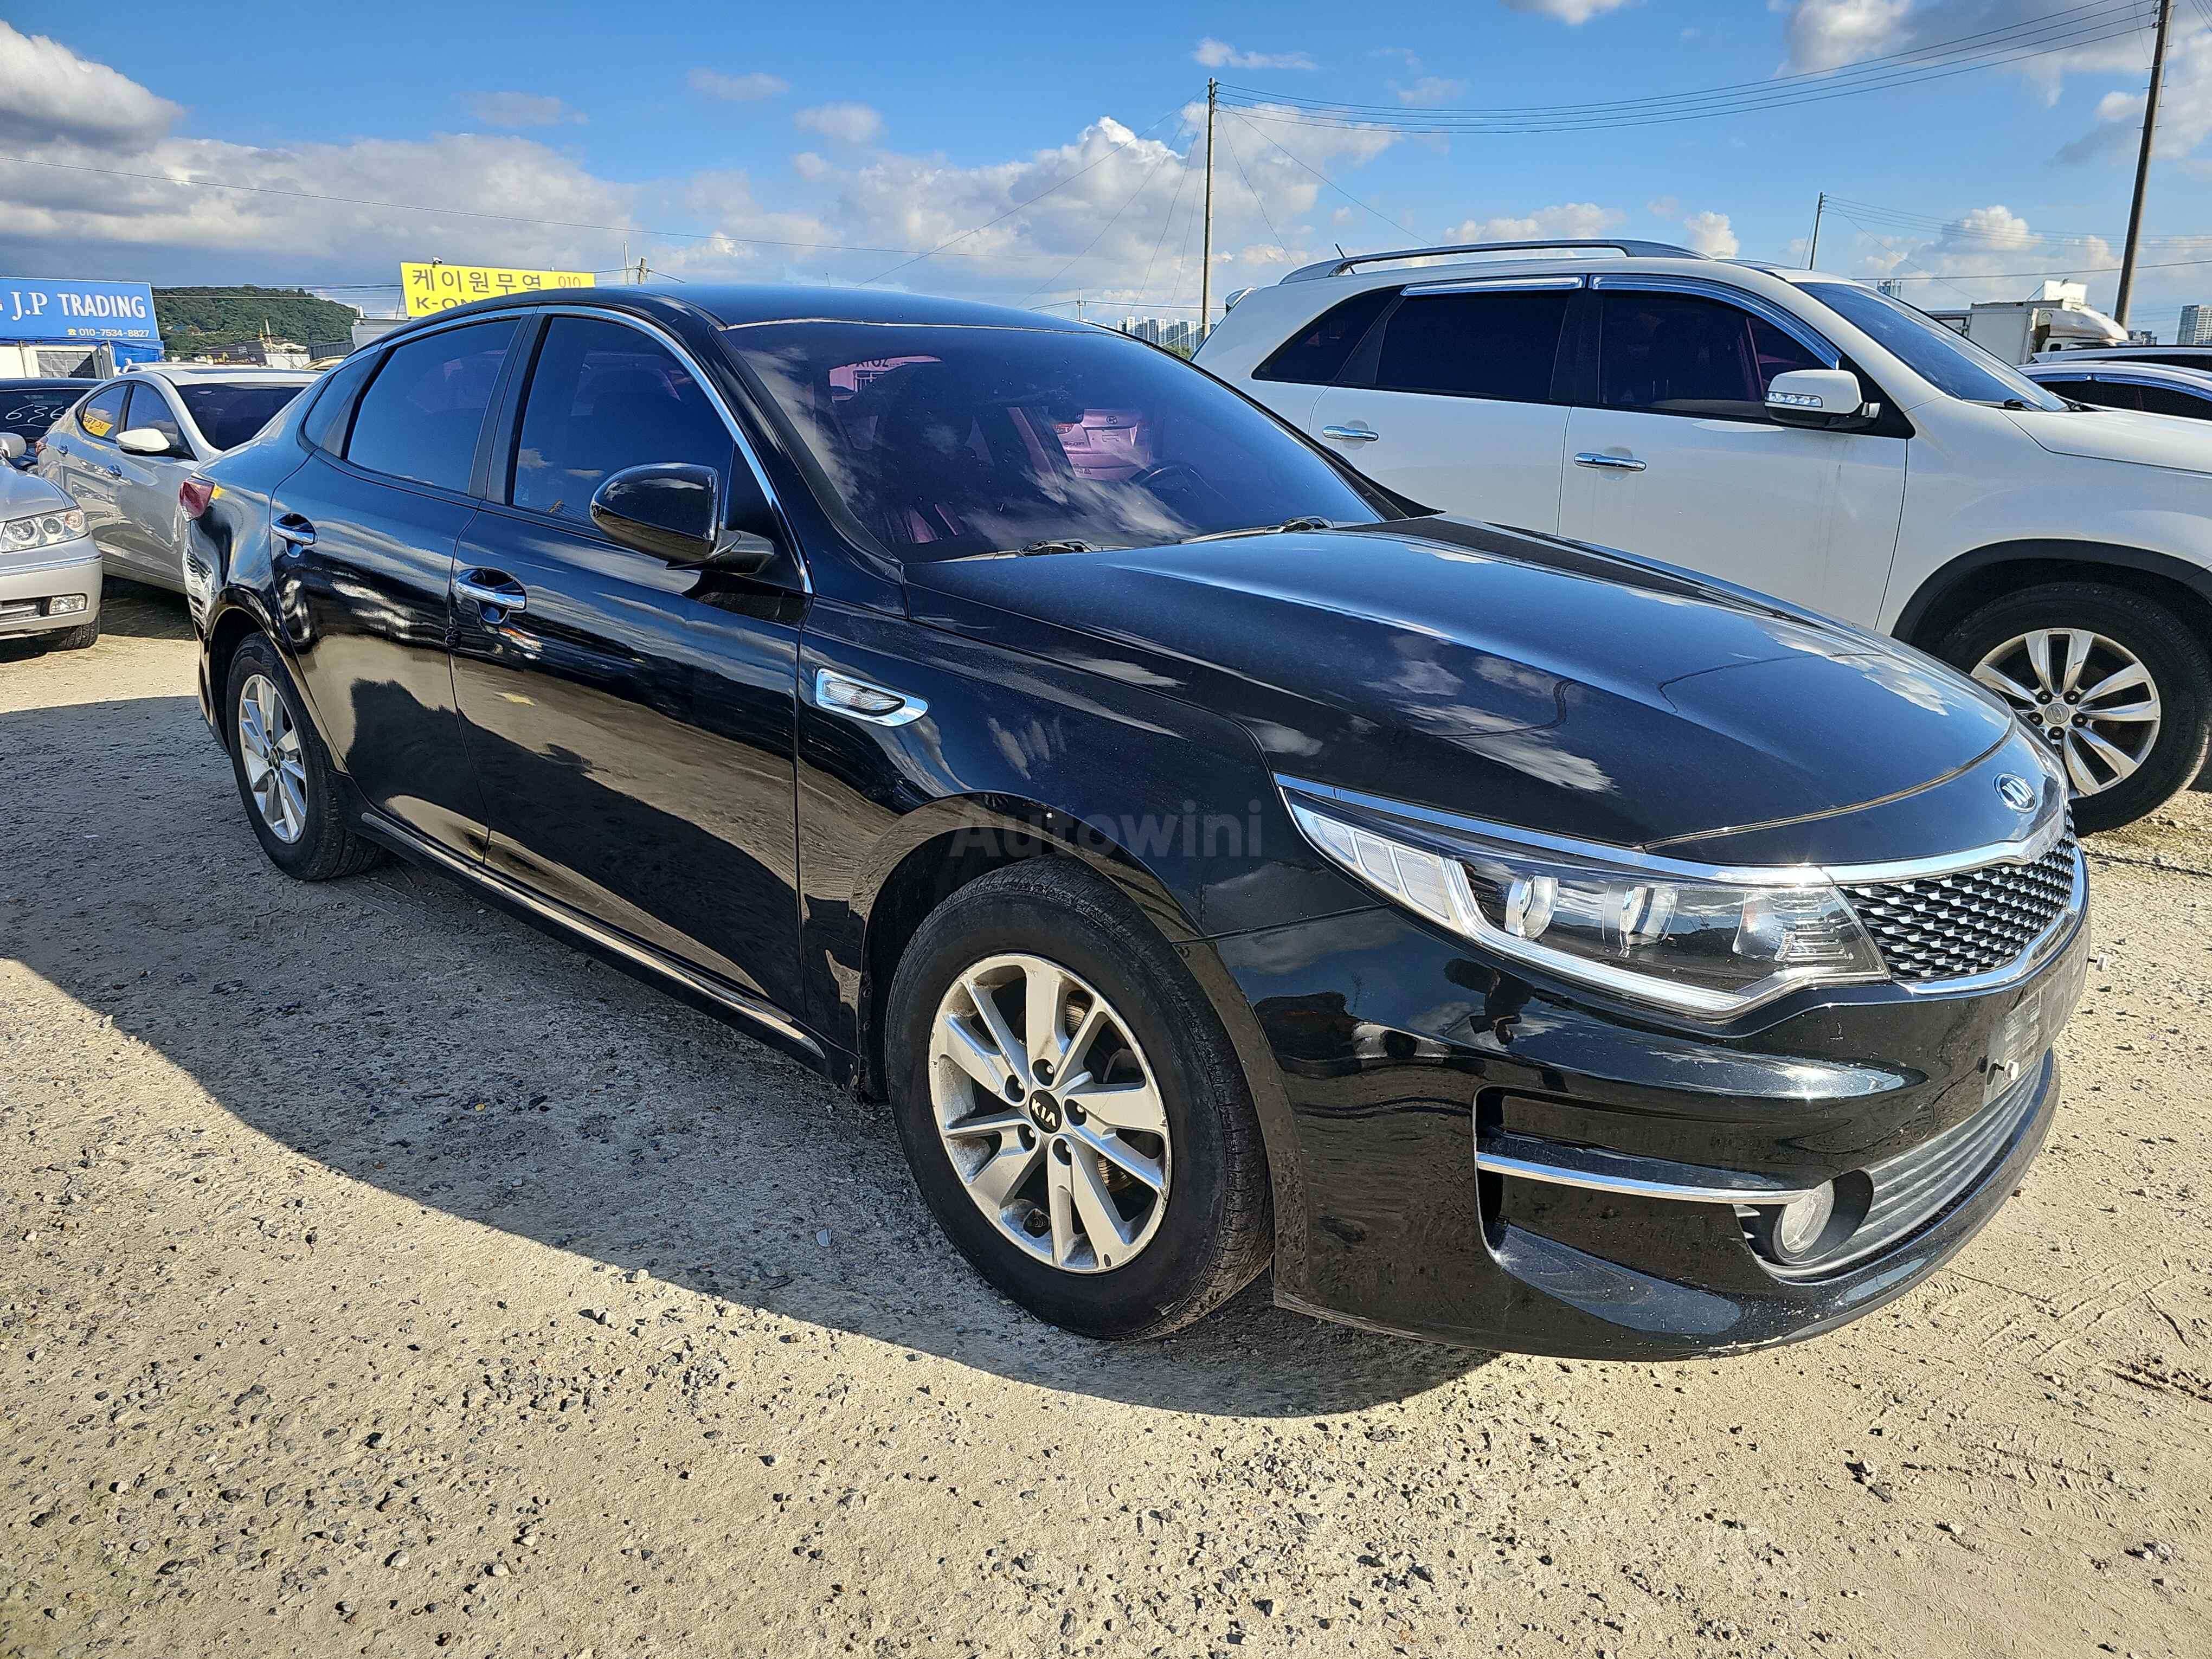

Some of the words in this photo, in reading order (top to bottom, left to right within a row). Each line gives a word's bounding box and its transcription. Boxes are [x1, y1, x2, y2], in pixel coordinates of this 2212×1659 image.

[412, 269, 541, 294] 케이원무역
[558, 275, 581, 288] 010
[10, 291, 48, 321] J.P
[57, 293, 146, 318] TRADING
[79, 328, 150, 337] 010-7534-8827
[5, 403, 70, 423] 636
[1032, 1098, 1056, 1127] KIA
